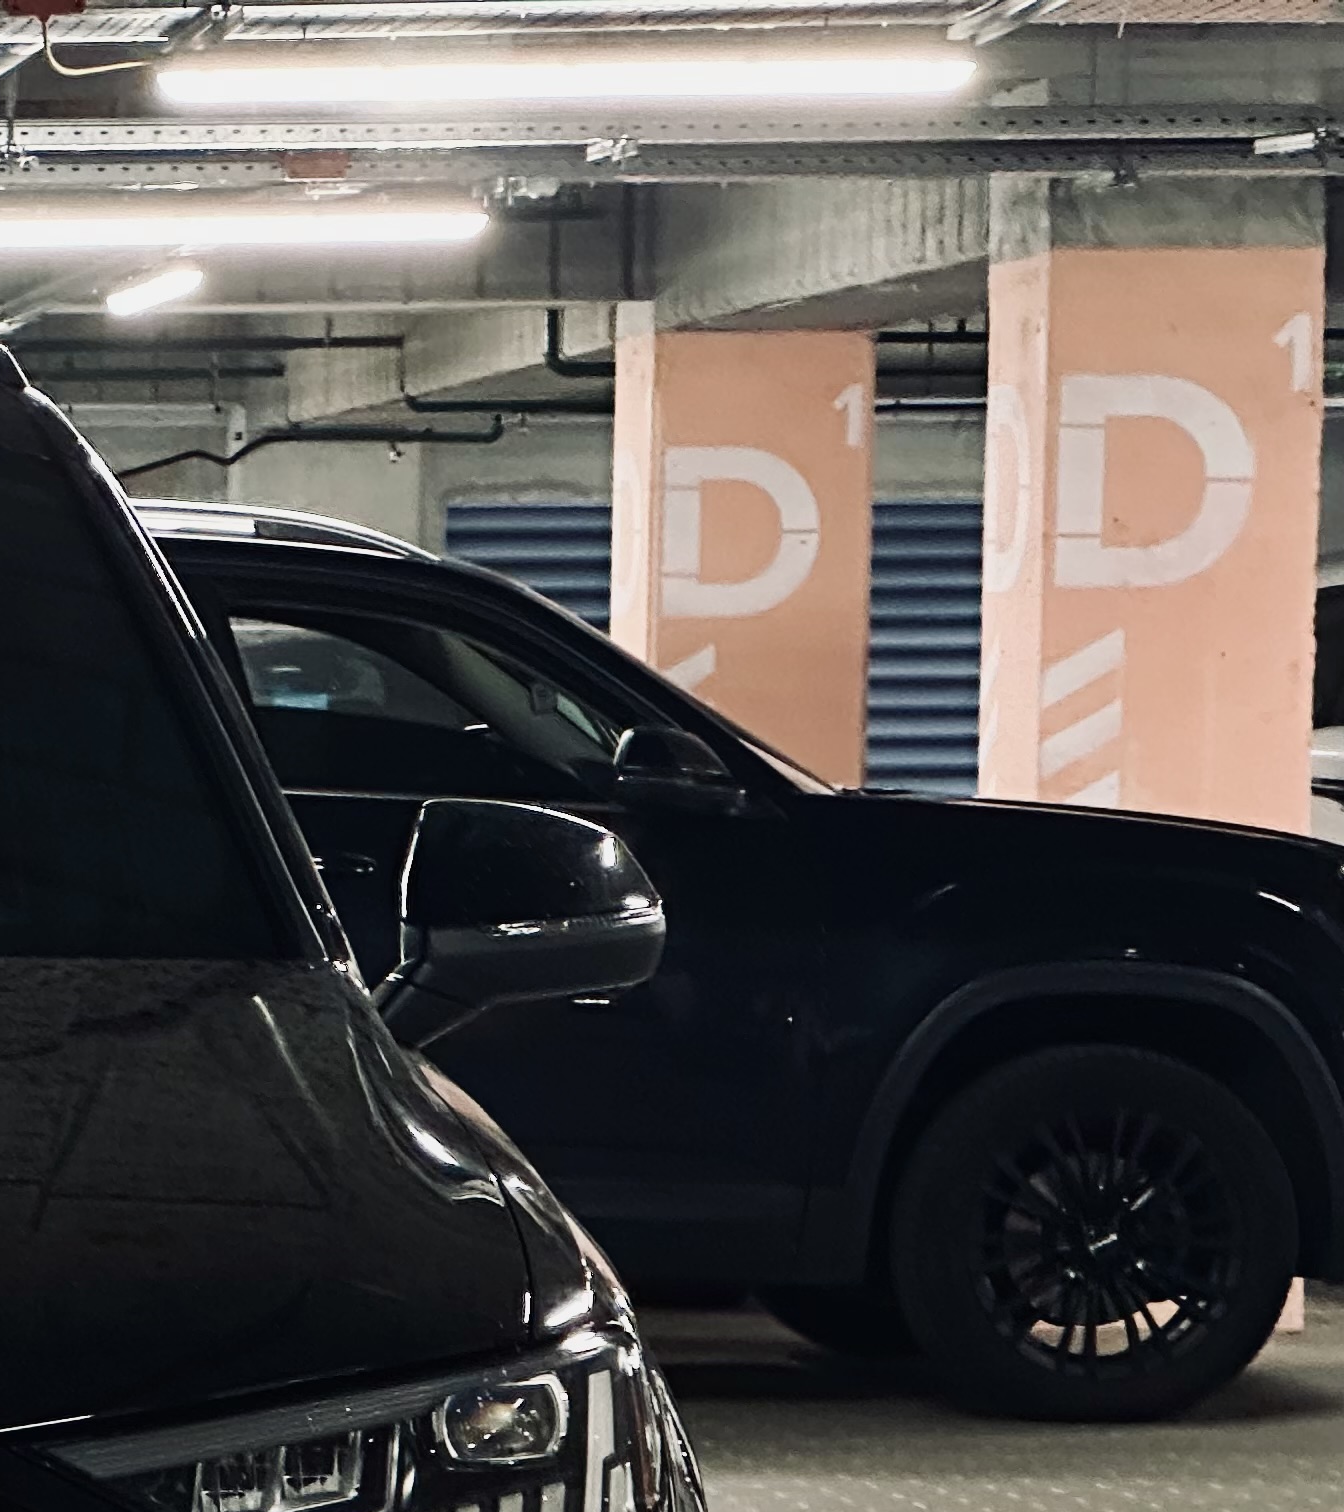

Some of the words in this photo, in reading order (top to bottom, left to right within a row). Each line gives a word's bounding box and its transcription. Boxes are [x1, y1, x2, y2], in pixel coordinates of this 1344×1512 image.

[660, 445, 821, 619] D
[833, 382, 866, 449] 1
[1054, 373, 1256, 589] D
[1272, 311, 1314, 392] 1
